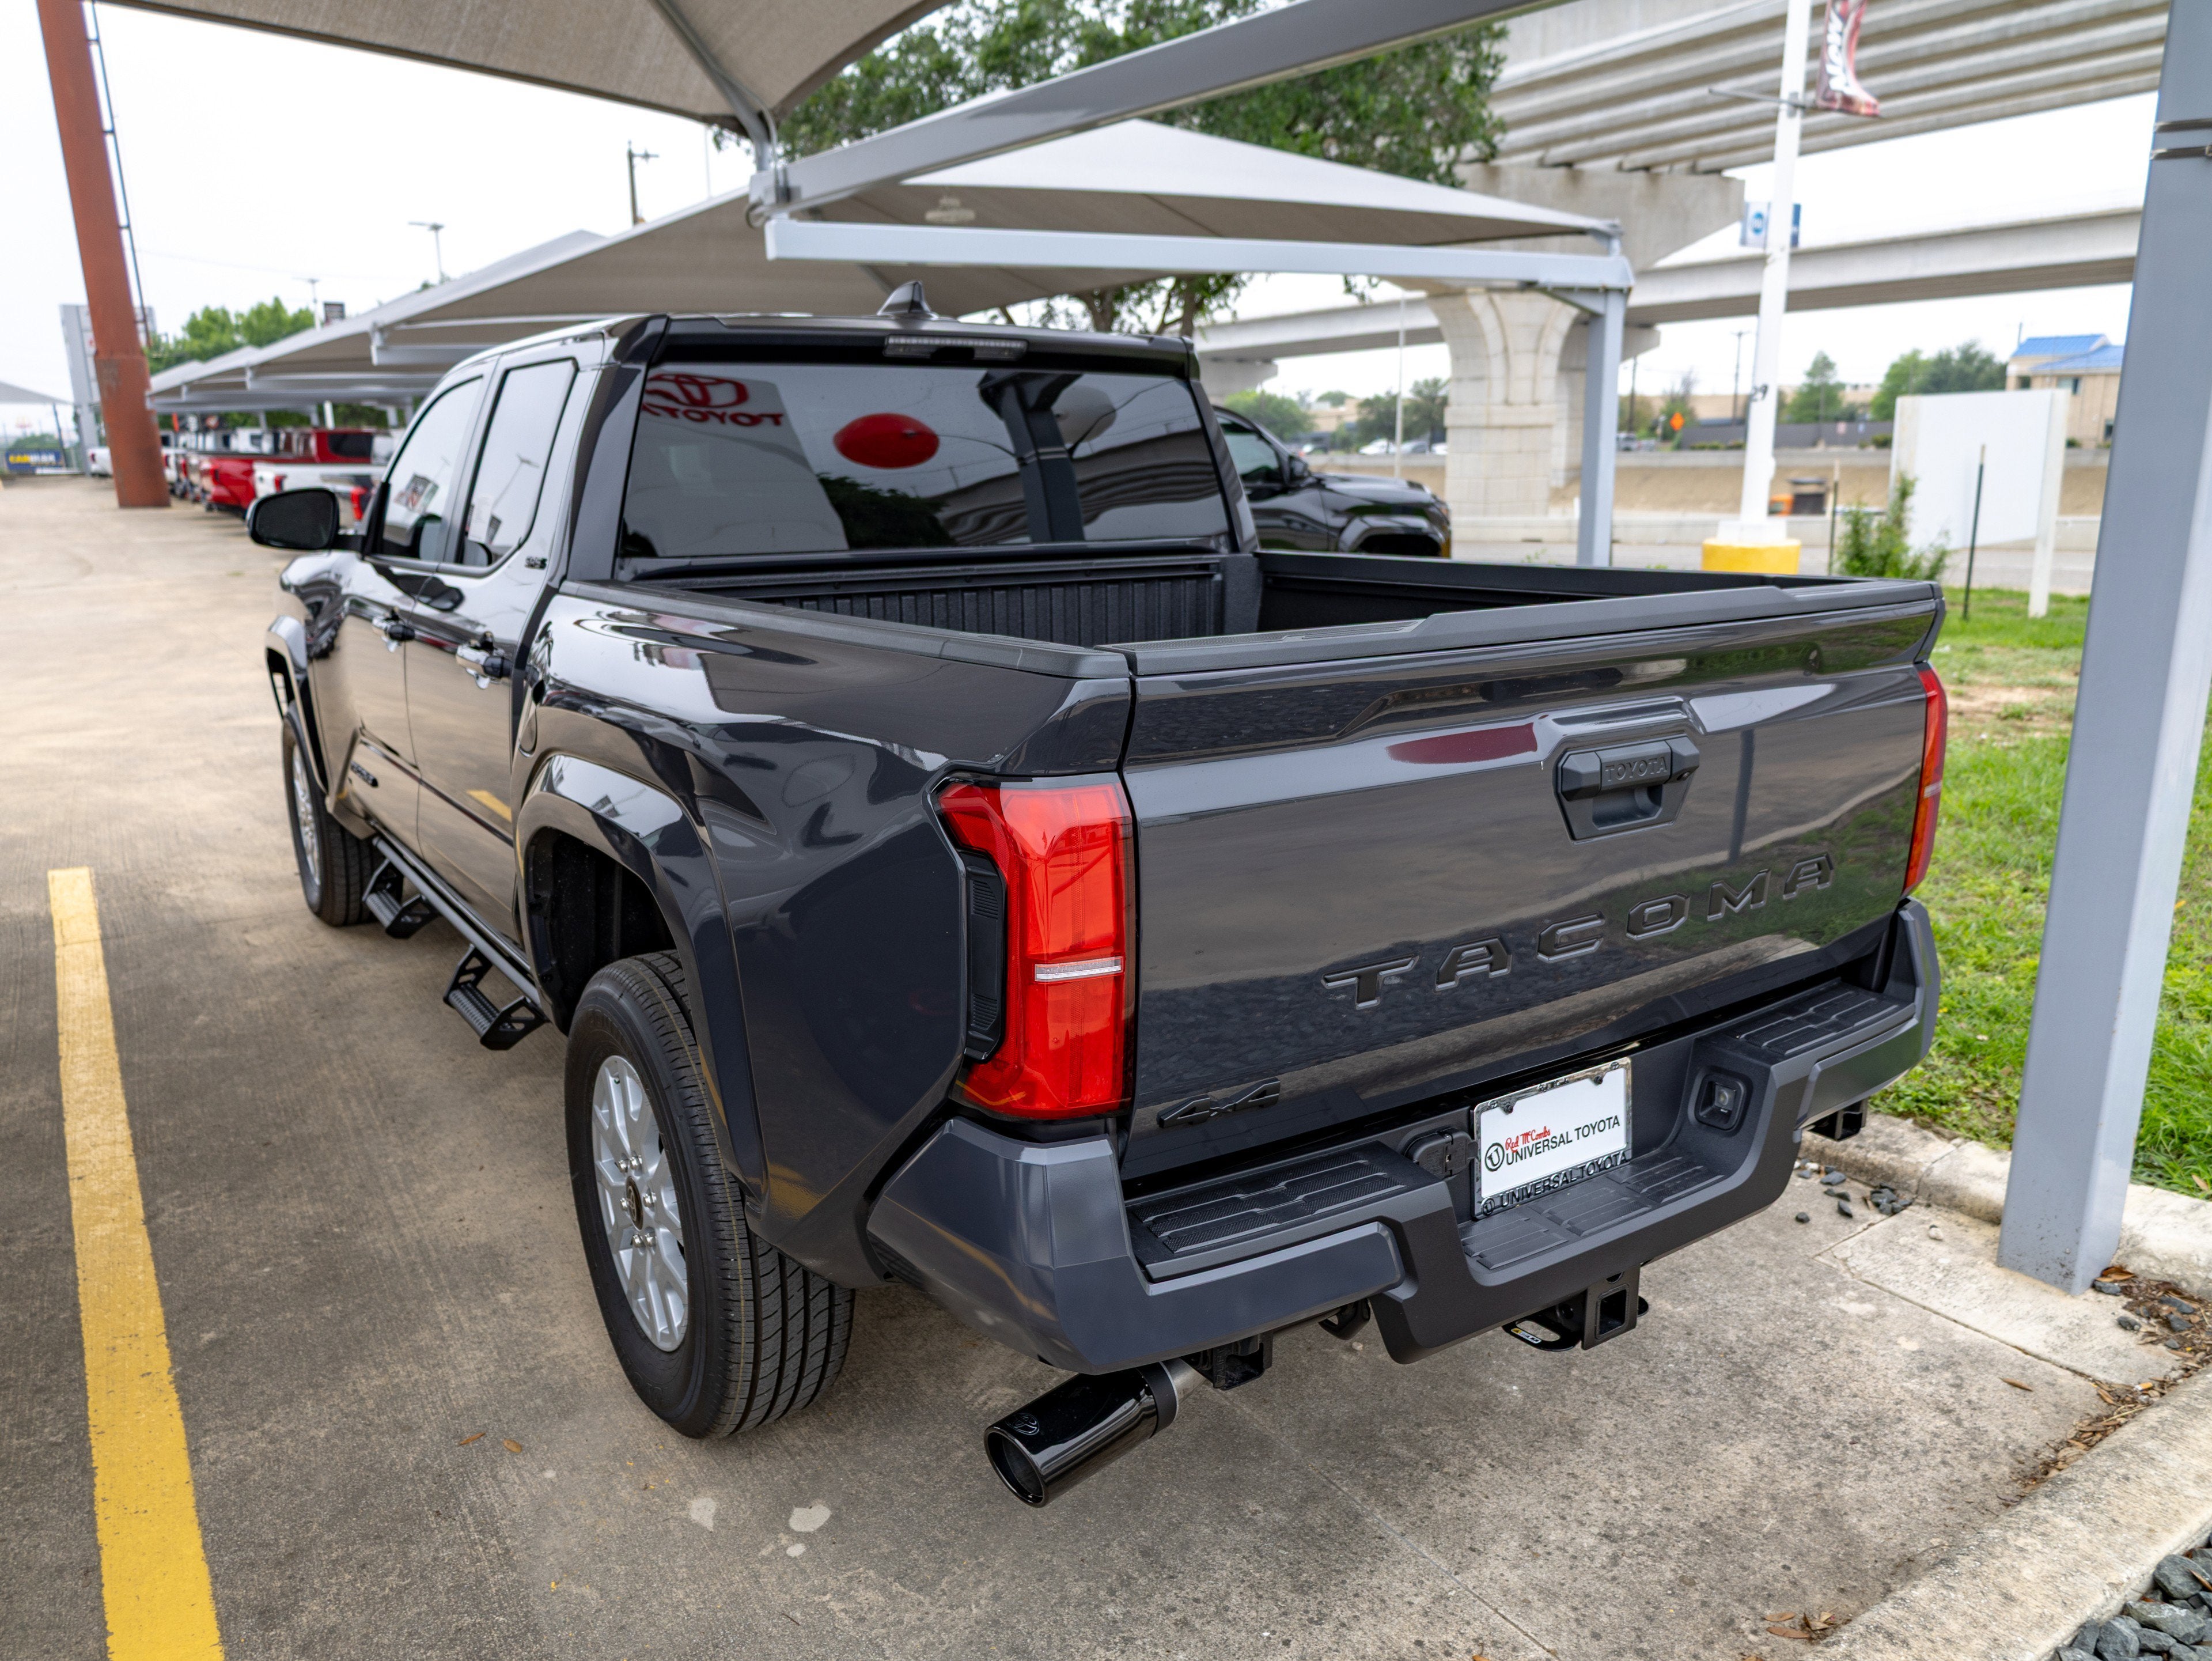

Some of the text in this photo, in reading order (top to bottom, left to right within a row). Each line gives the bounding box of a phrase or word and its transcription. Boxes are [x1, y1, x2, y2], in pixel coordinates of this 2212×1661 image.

[1605, 756, 1668, 782] TOYOTA
[1321, 853, 1835, 1010] TACOMA
[1505, 1126, 1551, 1153] Red McCombs
[1506, 1114, 1620, 1166] UNIVERSAL TOYOTA
[1499, 1150, 1628, 1208] UNIVERSAL TOYOTA
